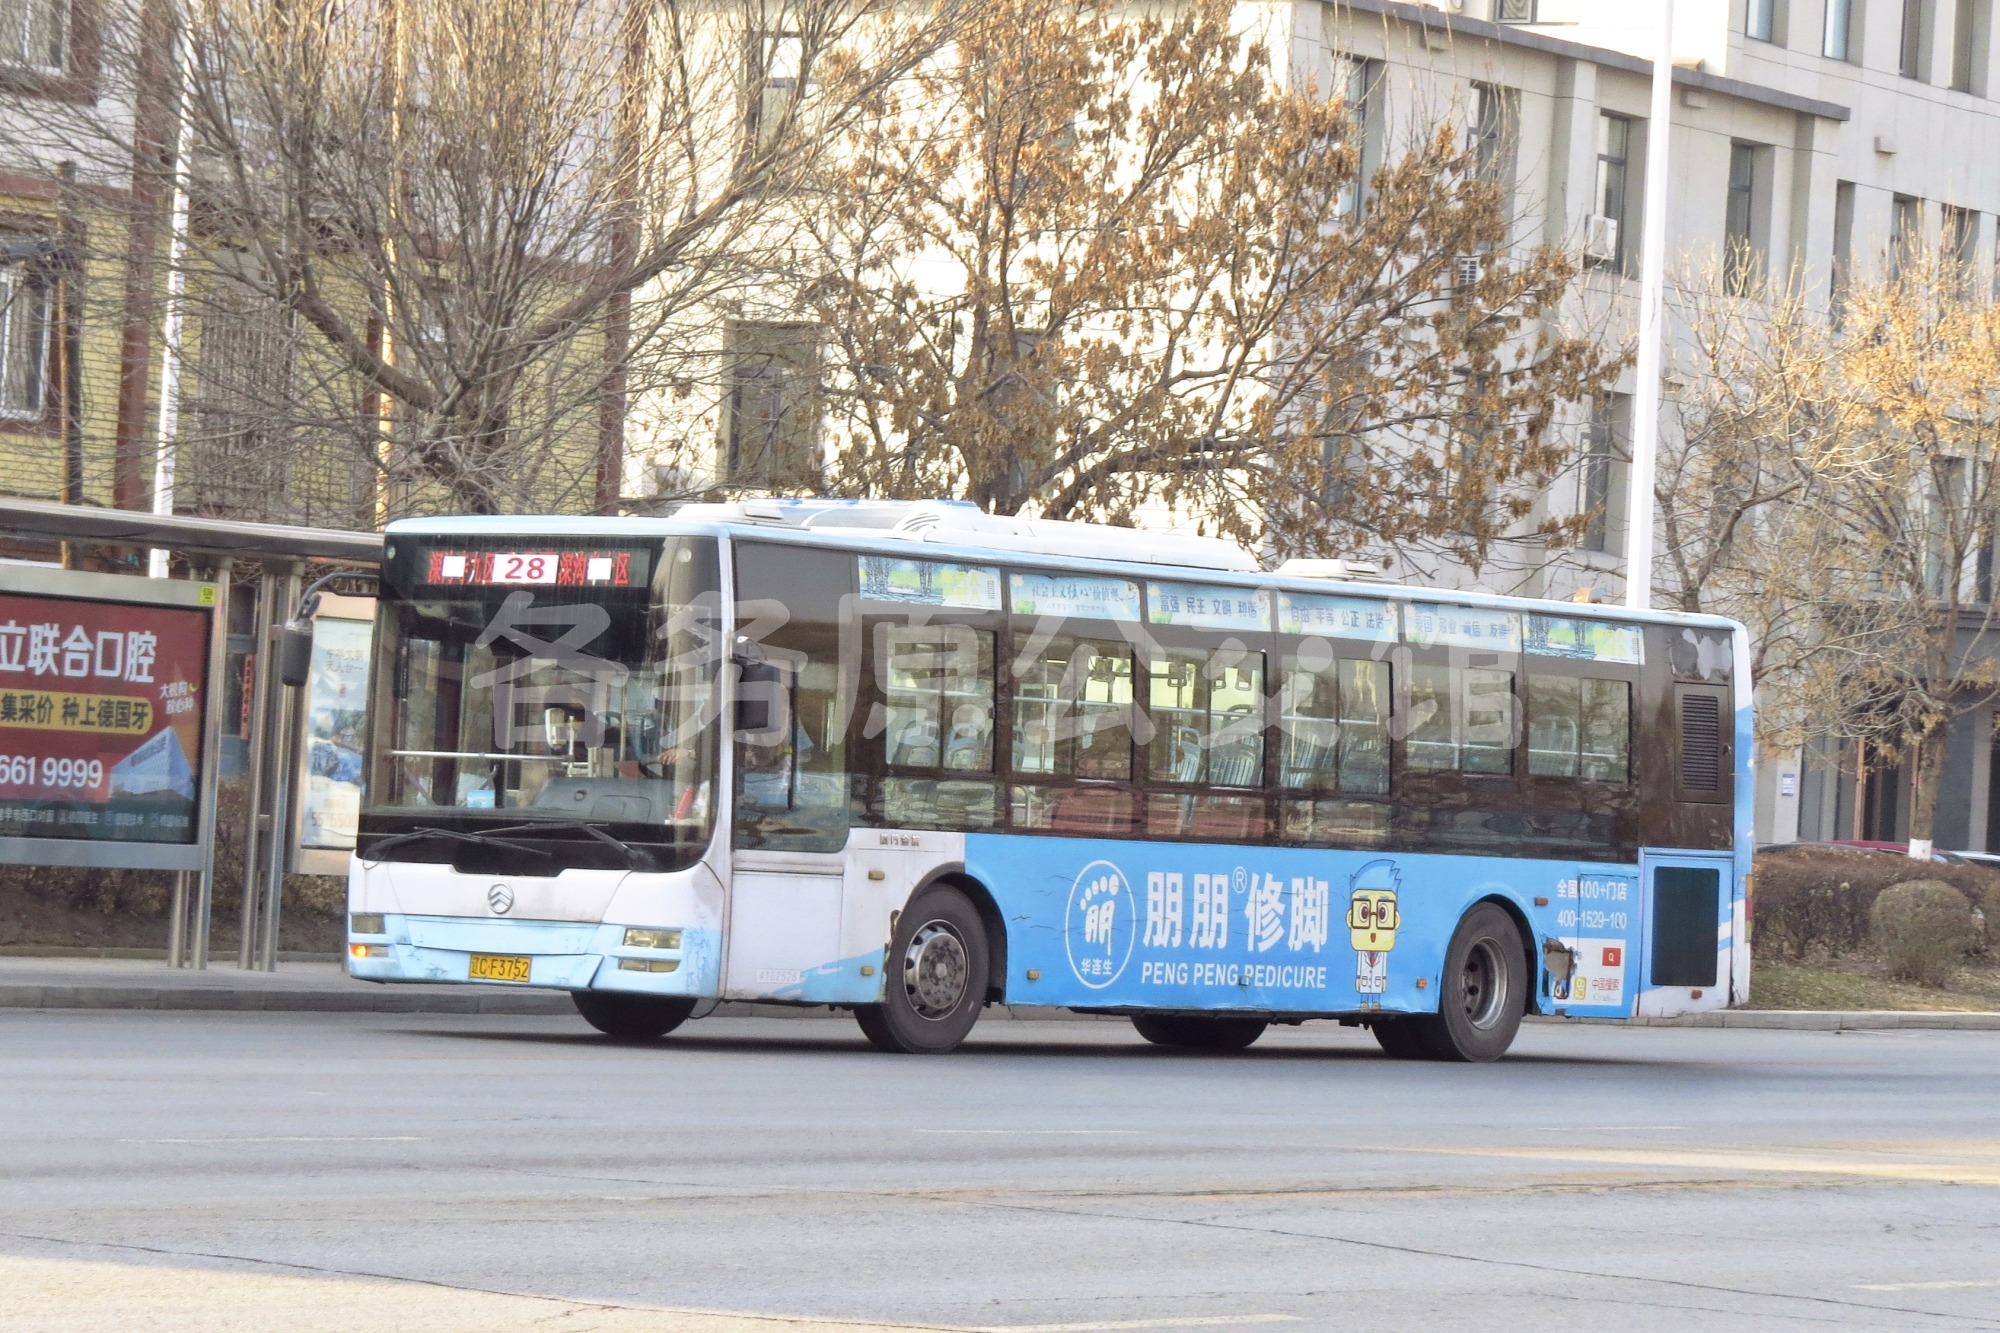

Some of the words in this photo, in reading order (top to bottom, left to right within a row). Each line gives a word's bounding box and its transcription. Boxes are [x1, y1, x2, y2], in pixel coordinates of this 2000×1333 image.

[504, 557, 546, 580] 28
[1161, 594, 1180, 613] 富强
[1187, 596, 1206, 615] 民主
[1212, 598, 1232, 617] 文明
[1238, 600, 1258, 619] 和谐
[1291, 605, 1310, 623] 自由
[1316, 607, 1335, 626] 平等
[1341, 609, 1360, 628] 公正
[1366, 611, 1385, 630] 法治
[0, 621, 156, 683] 立联合口腔
[0, 692, 54, 724] 集采价
[62, 697, 149, 730] 种上德国牙
[42, 757, 102, 789] 9999
[1557, 910, 1627, 929] 400-1529-100
[1081, 957, 1113, 976] 华连生
[1141, 962, 1188, 985] PENG
[1192, 963, 1240, 986] PENG
[1244, 964, 1327, 989] PEDICURE
